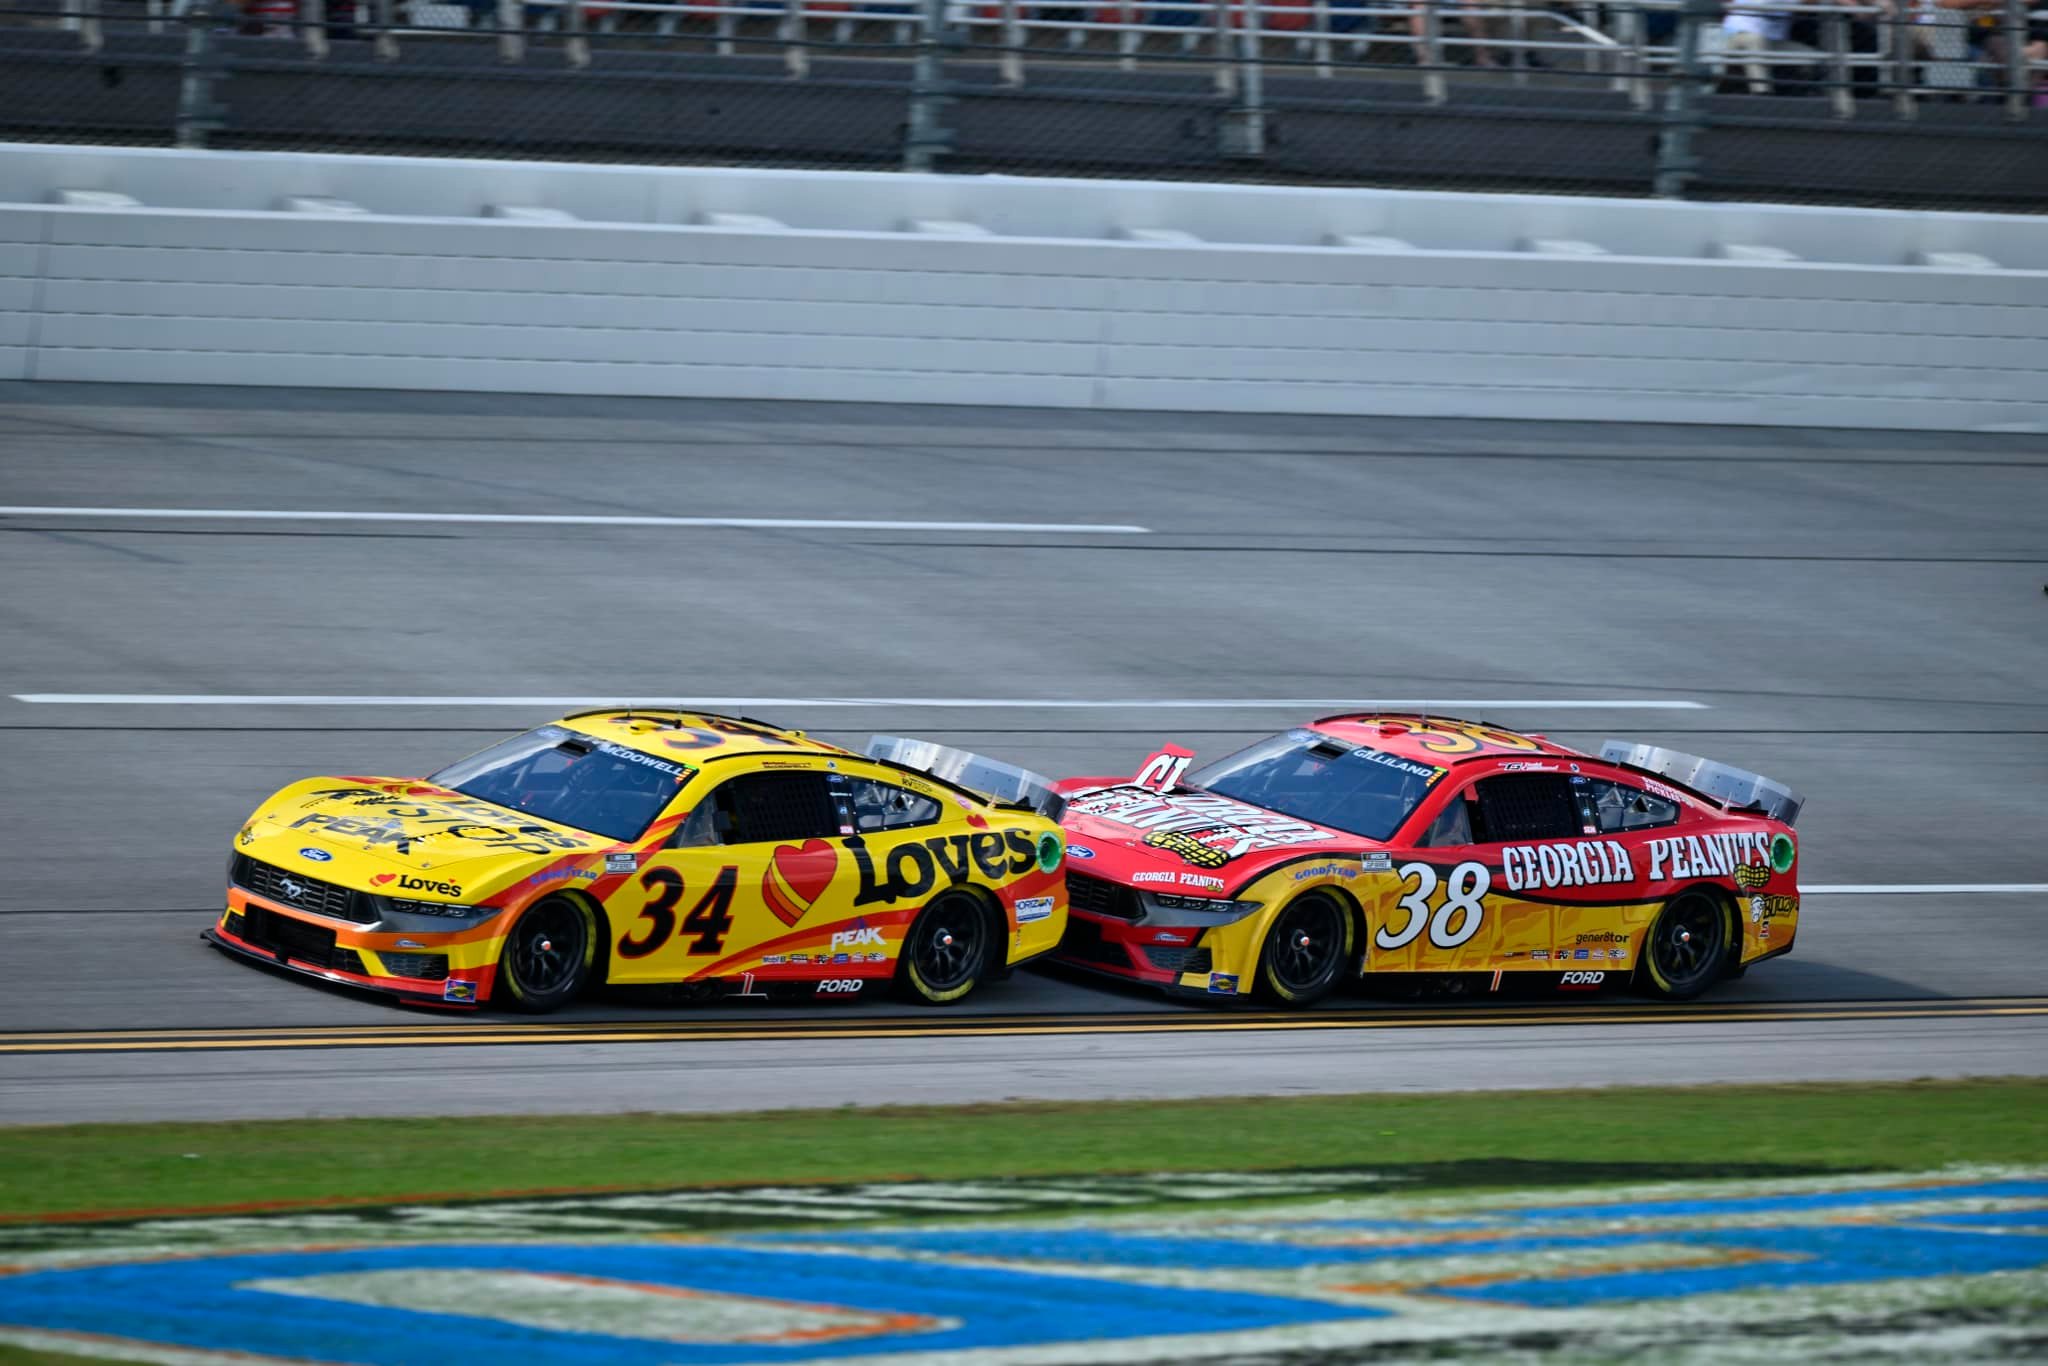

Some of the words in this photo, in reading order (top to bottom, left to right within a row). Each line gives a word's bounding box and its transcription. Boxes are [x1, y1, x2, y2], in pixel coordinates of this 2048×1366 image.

[1353, 748, 1433, 778] GILLILAND
[290, 812, 410, 856] PEAK
[1294, 863, 1357, 881] GOODYEAR
[1502, 840, 1634, 891] GEORGIA
[1642, 831, 1771, 881] PEANUTS
[1132, 871, 1176, 884] GEORGIA
[1178, 872, 1225, 890] PEANUTS
[617, 865, 740, 958] 34
[1375, 861, 1491, 949] 38
[830, 926, 887, 952] PEAK
[1575, 931, 1630, 945] gener8tor
[816, 979, 863, 993] FORD
[1560, 971, 1605, 984] FORD
